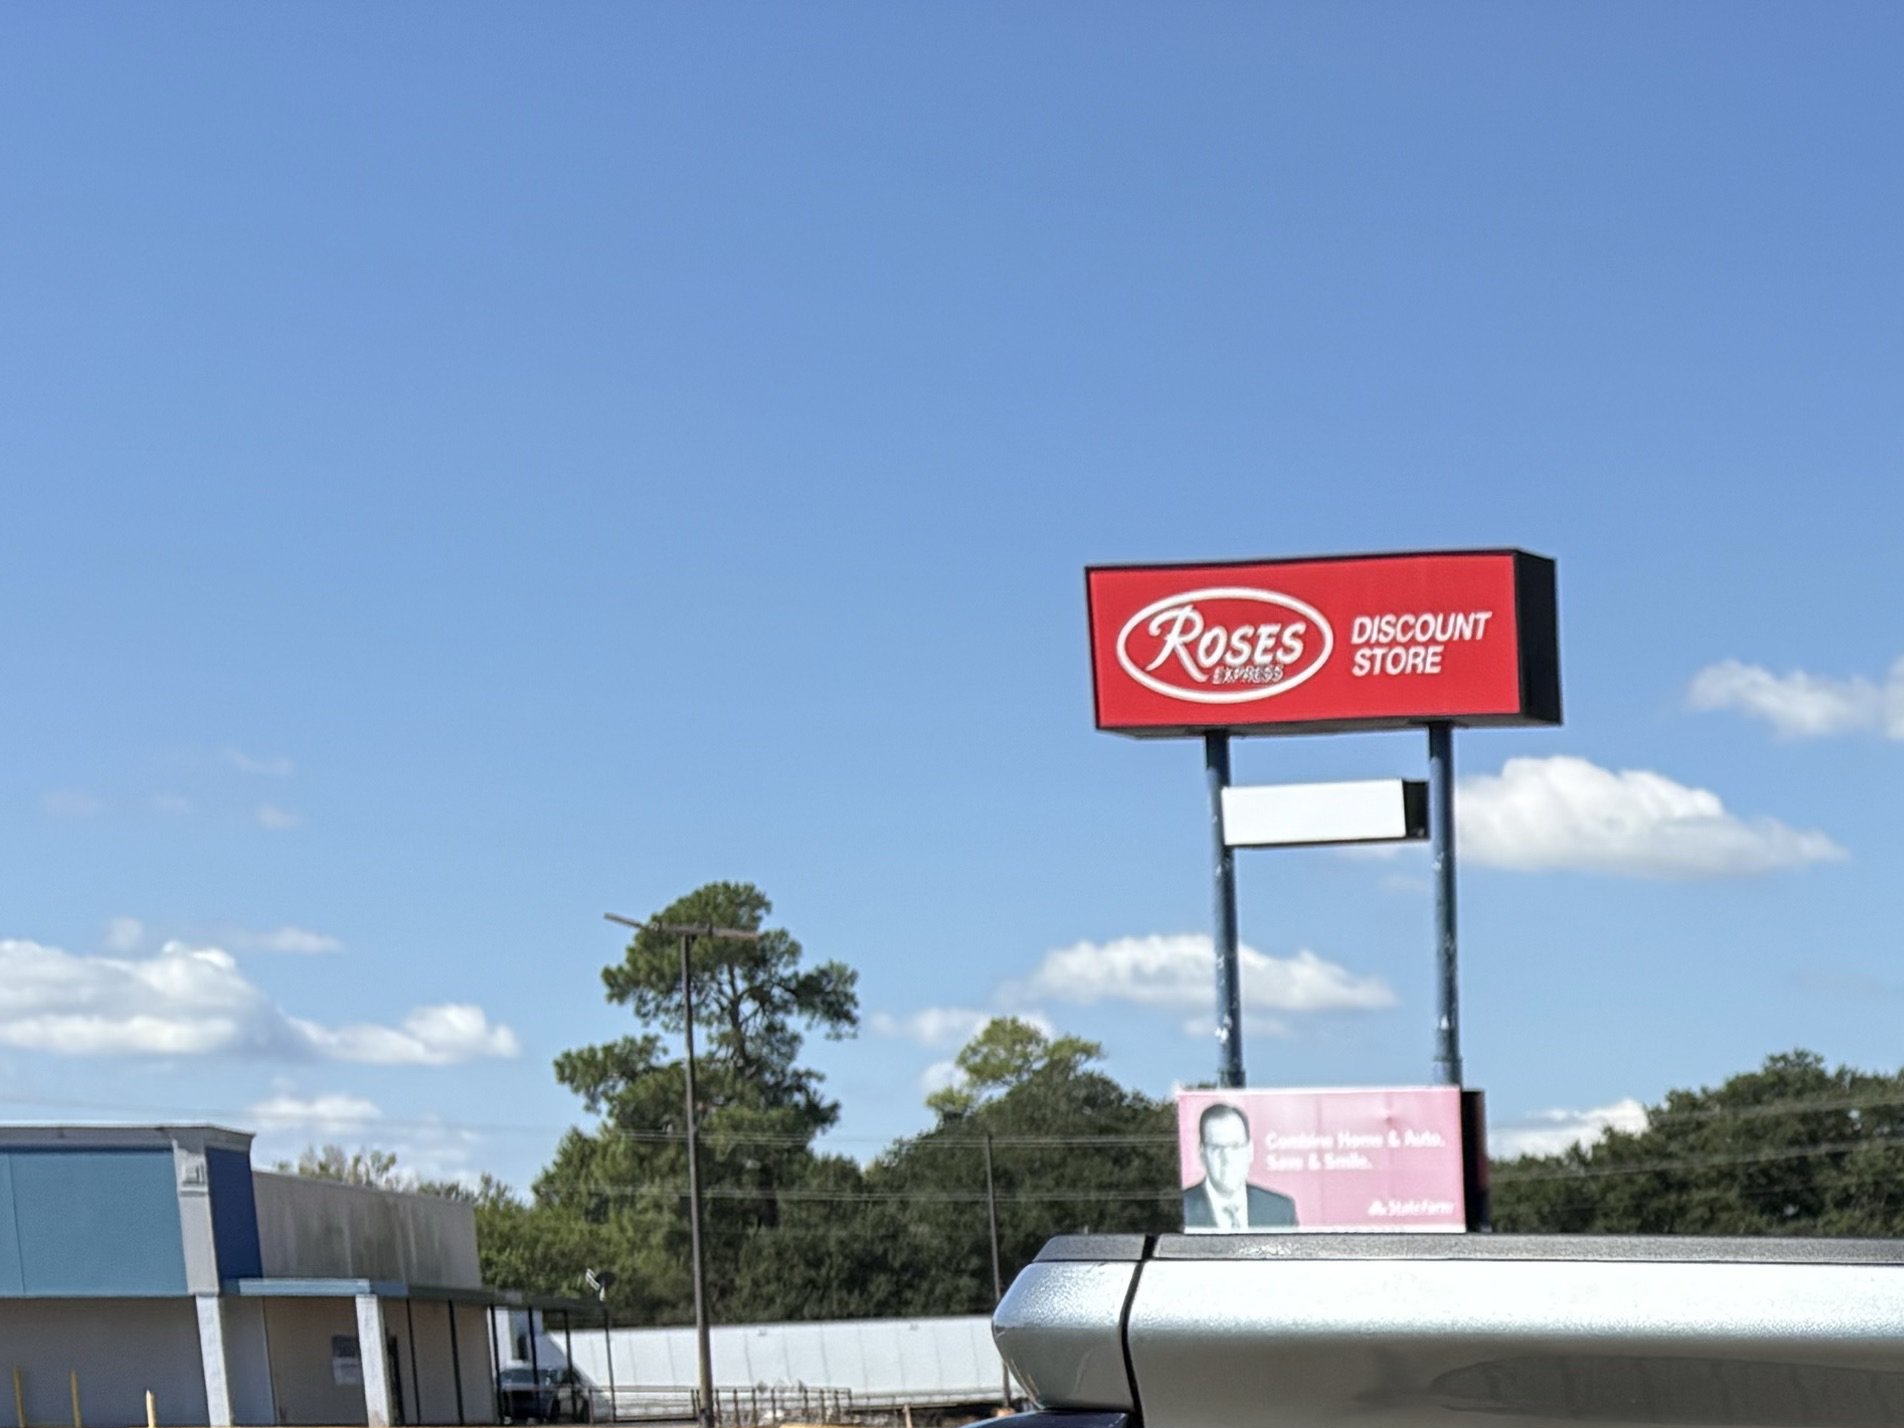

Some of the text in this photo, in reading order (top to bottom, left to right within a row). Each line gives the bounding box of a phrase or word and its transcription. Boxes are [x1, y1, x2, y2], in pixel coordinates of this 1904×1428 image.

[1351, 611, 1493, 645] DISCOUNT
[1351, 646, 1445, 677] STORE
[1212, 665, 1283, 685] EXPRESS
[1337, 1131, 1384, 1148] Home
[1388, 1129, 1401, 1148] &
[1308, 1153, 1321, 1170] &
